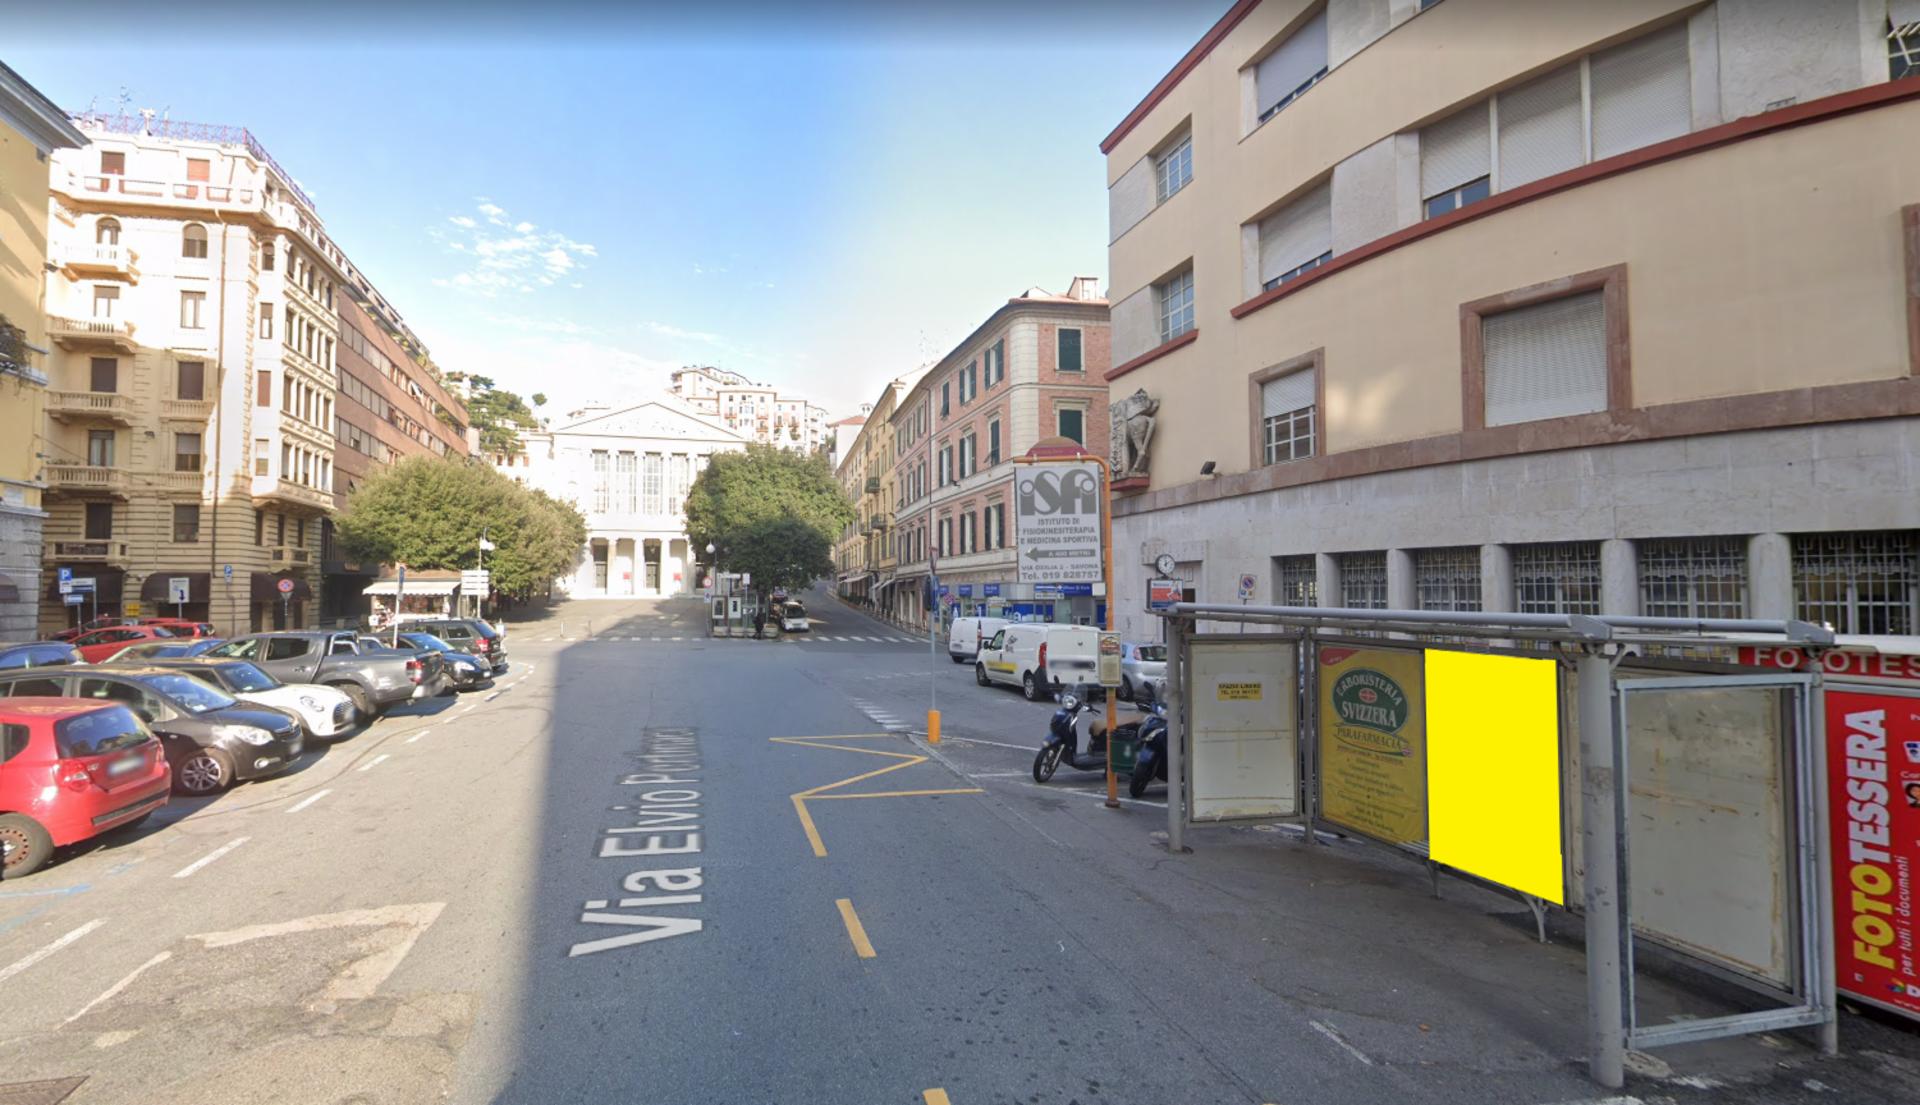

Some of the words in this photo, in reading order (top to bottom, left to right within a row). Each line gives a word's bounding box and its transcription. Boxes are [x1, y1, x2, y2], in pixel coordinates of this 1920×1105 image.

[1022, 526, 1096, 535] FISIOKINESITERAPIA
[1038, 518, 1071, 526] ISTITUTO
[1072, 517, 1080, 525] DI
[1027, 537, 1061, 545] MEDICINA
[1062, 535, 1098, 544] SPORTIVA
[1021, 571, 1040, 581] Tel.
[1042, 571, 1060, 579] 019
[1070, 562, 1099, 570] SAVONA
[1753, 646, 1920, 680] FOOTES
[1335, 674, 1403, 707] ERBORISTERIA
[1341, 700, 1397, 728] SVIZZERA
[1336, 728, 1402, 750] PARAFARMACIA
[1844, 708, 1895, 969] FOTOTESSERA
[1895, 855, 1911, 917] documenti
[1899, 927, 1912, 951] tutti
[1901, 953, 1915, 976] per
